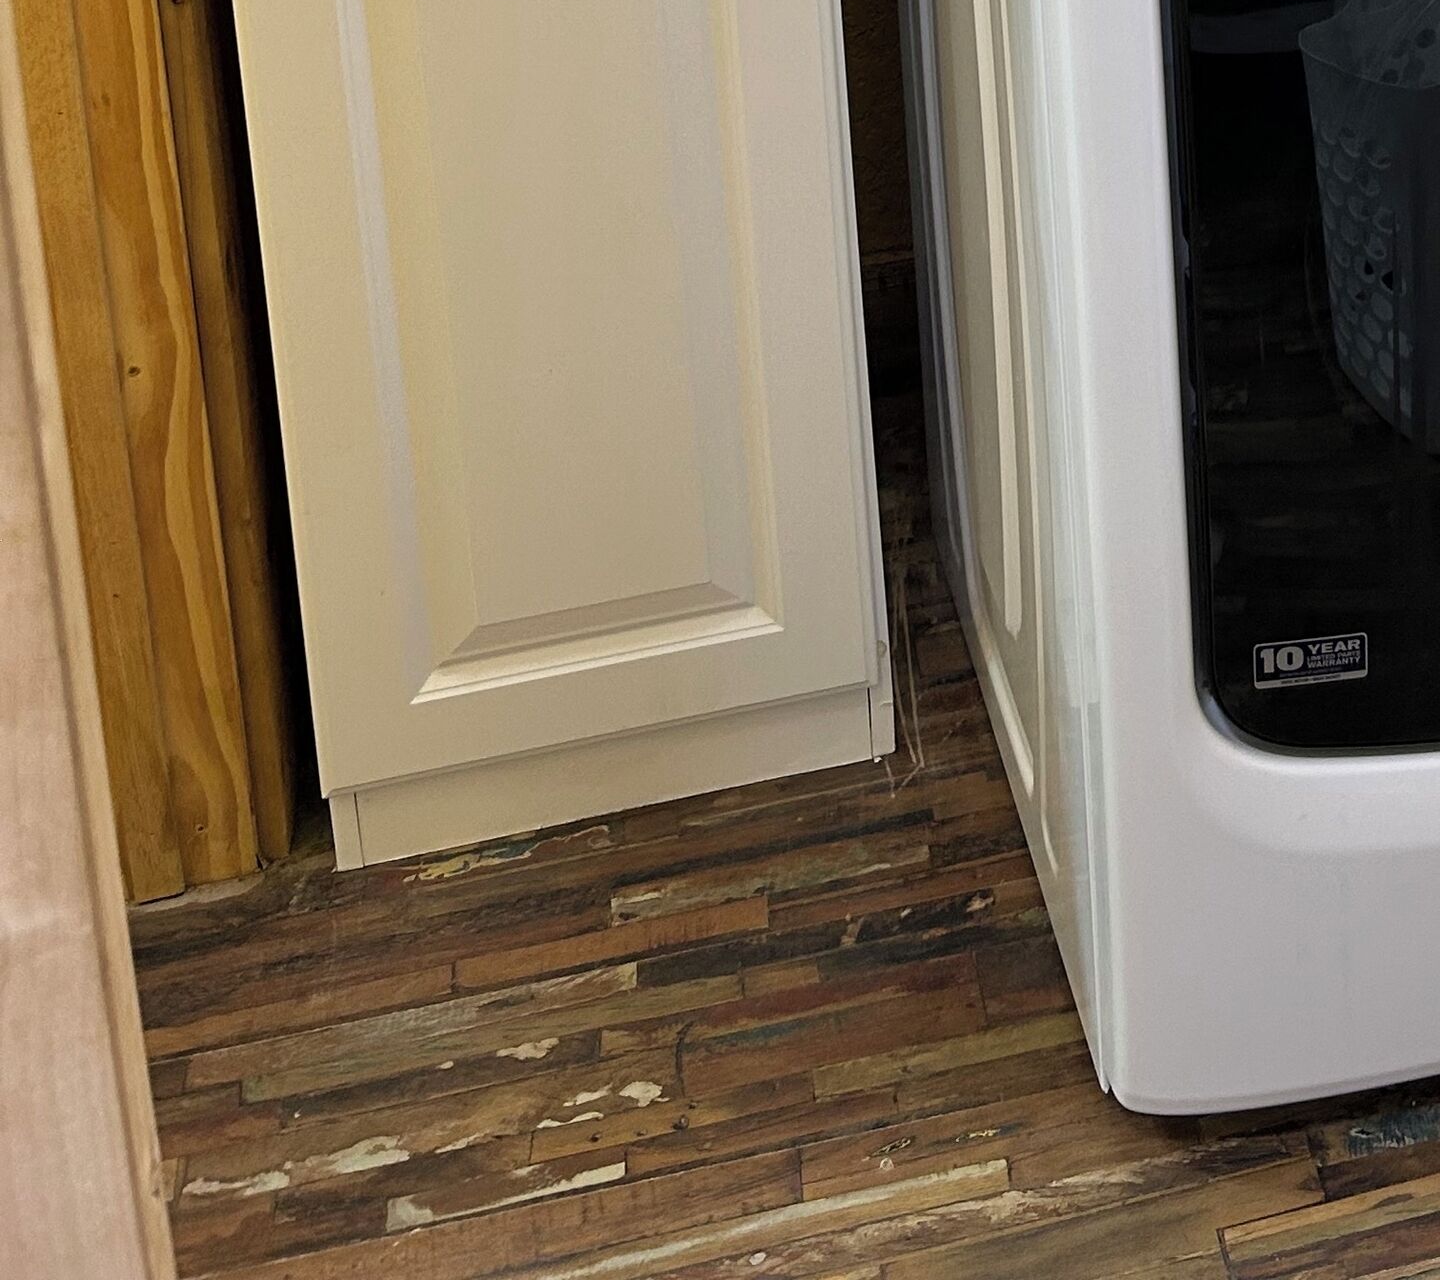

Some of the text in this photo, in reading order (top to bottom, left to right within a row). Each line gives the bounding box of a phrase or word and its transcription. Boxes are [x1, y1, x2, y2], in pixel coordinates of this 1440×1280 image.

[1261, 646, 1304, 673] 10
[1307, 639, 1360, 654] YEAR
[1307, 657, 1360, 668] WARRANTY
